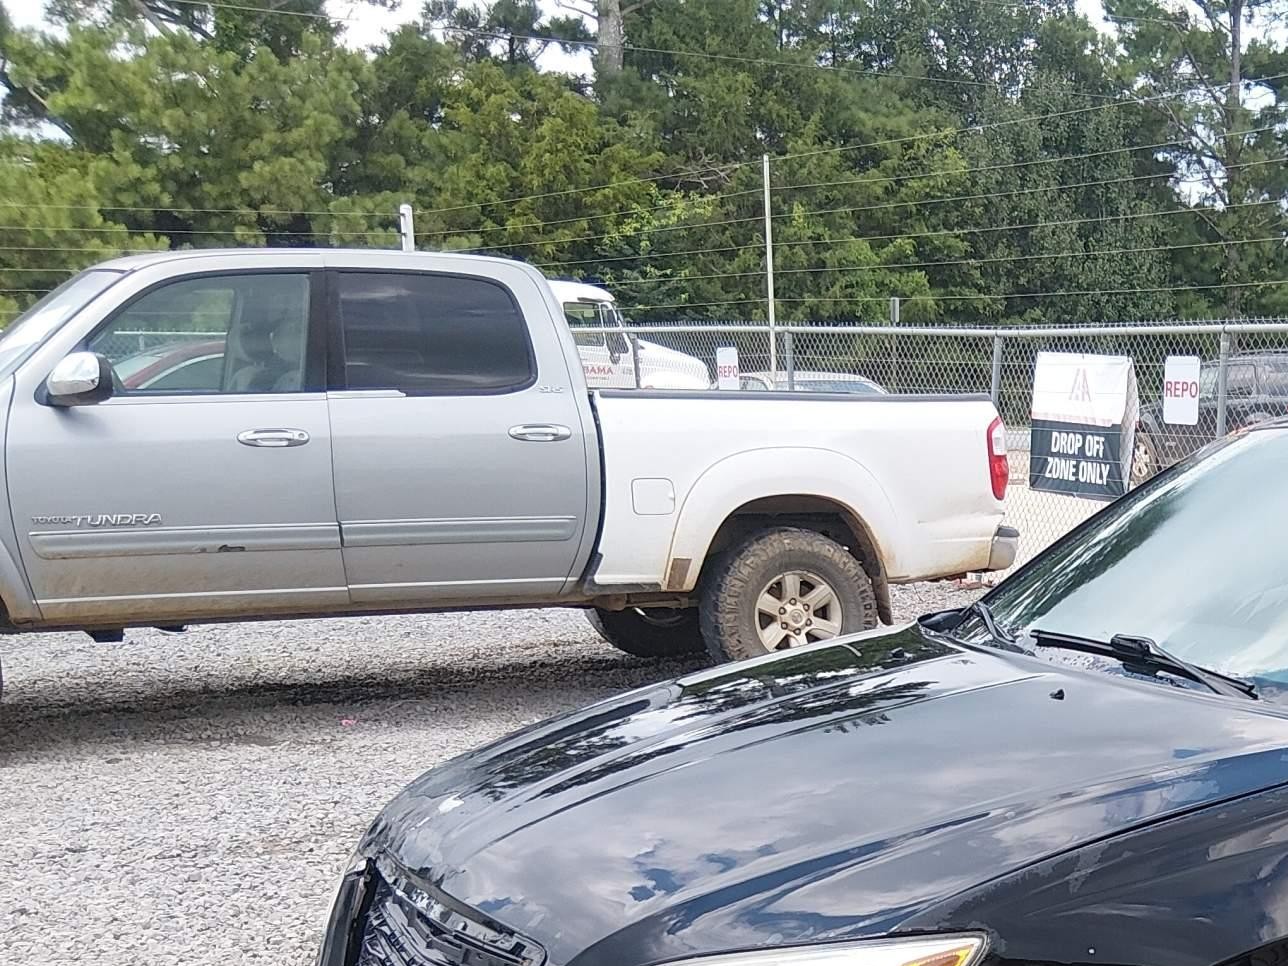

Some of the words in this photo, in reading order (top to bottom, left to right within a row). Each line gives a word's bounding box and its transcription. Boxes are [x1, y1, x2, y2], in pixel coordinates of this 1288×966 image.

[718, 365, 738, 378] REPO
[1165, 381, 1199, 399] REPO
[1051, 431, 1082, 456] DROP
[1084, 434, 1105, 459] OFF
[1044, 456, 1077, 482] ZONE
[1078, 460, 1111, 486] ONLY
[72, 513, 162, 527] TUNDRA
